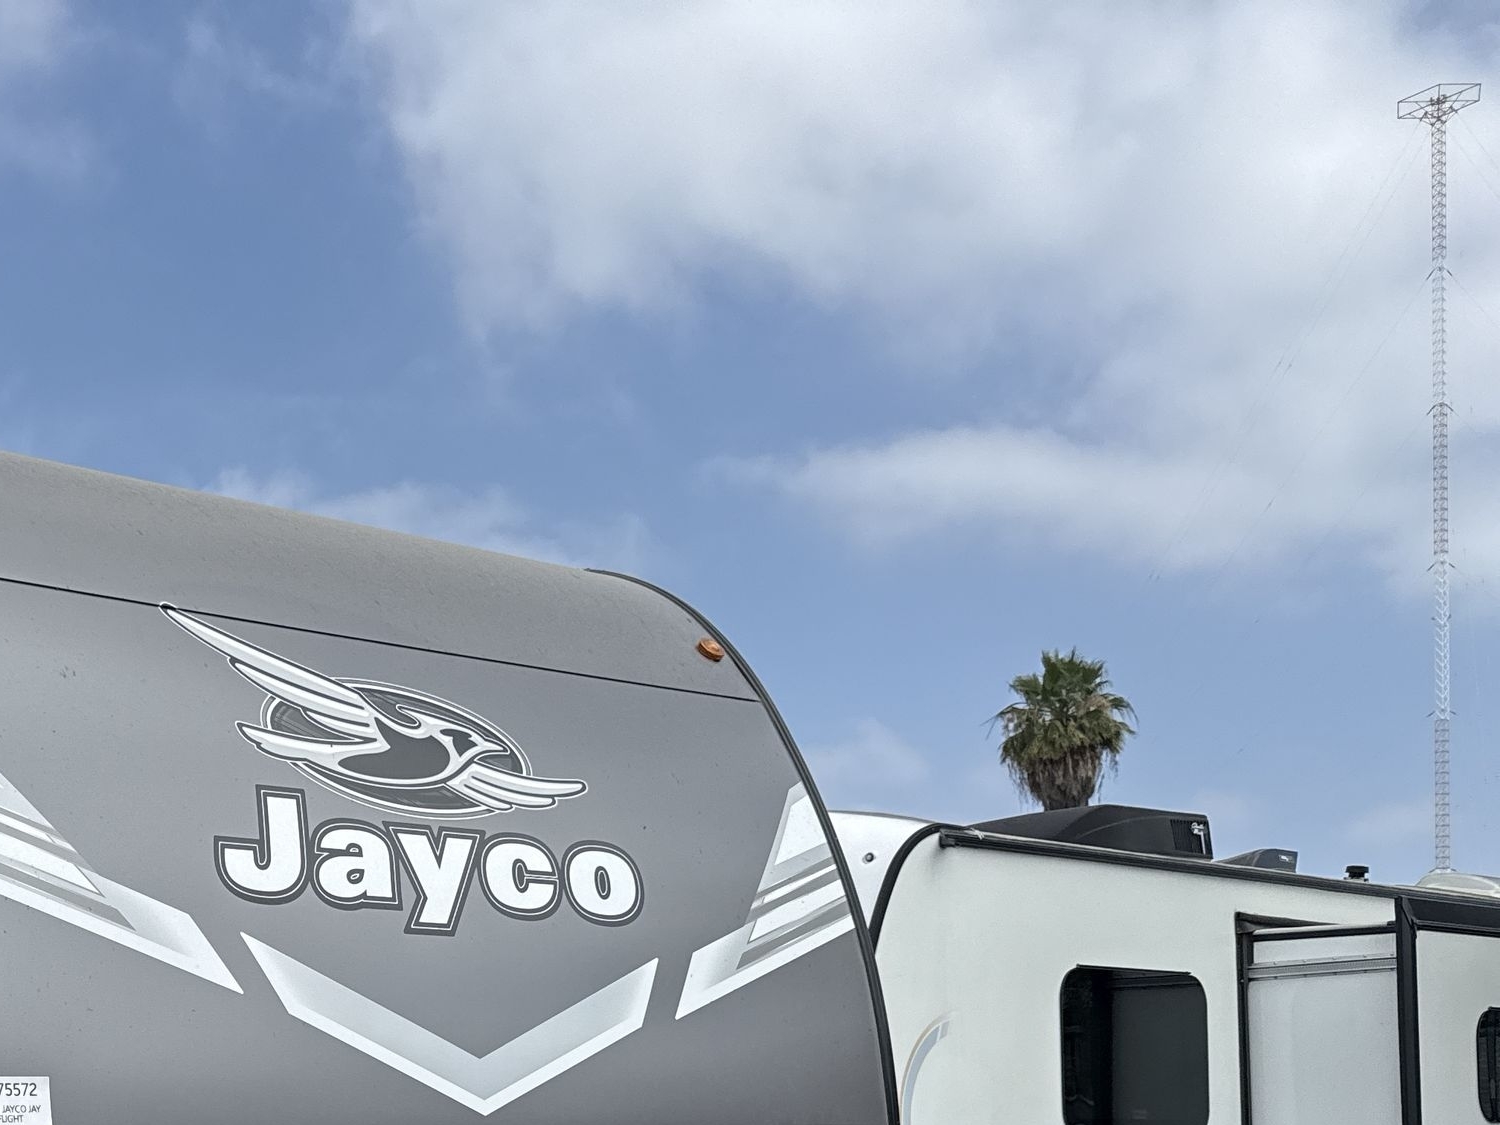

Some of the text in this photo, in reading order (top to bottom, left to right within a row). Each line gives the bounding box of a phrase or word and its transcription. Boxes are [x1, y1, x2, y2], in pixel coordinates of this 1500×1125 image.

[214, 784, 645, 936] Jayco
[2, 1104, 27, 1114] JAYCO
[28, 1104, 41, 1113] JAY
